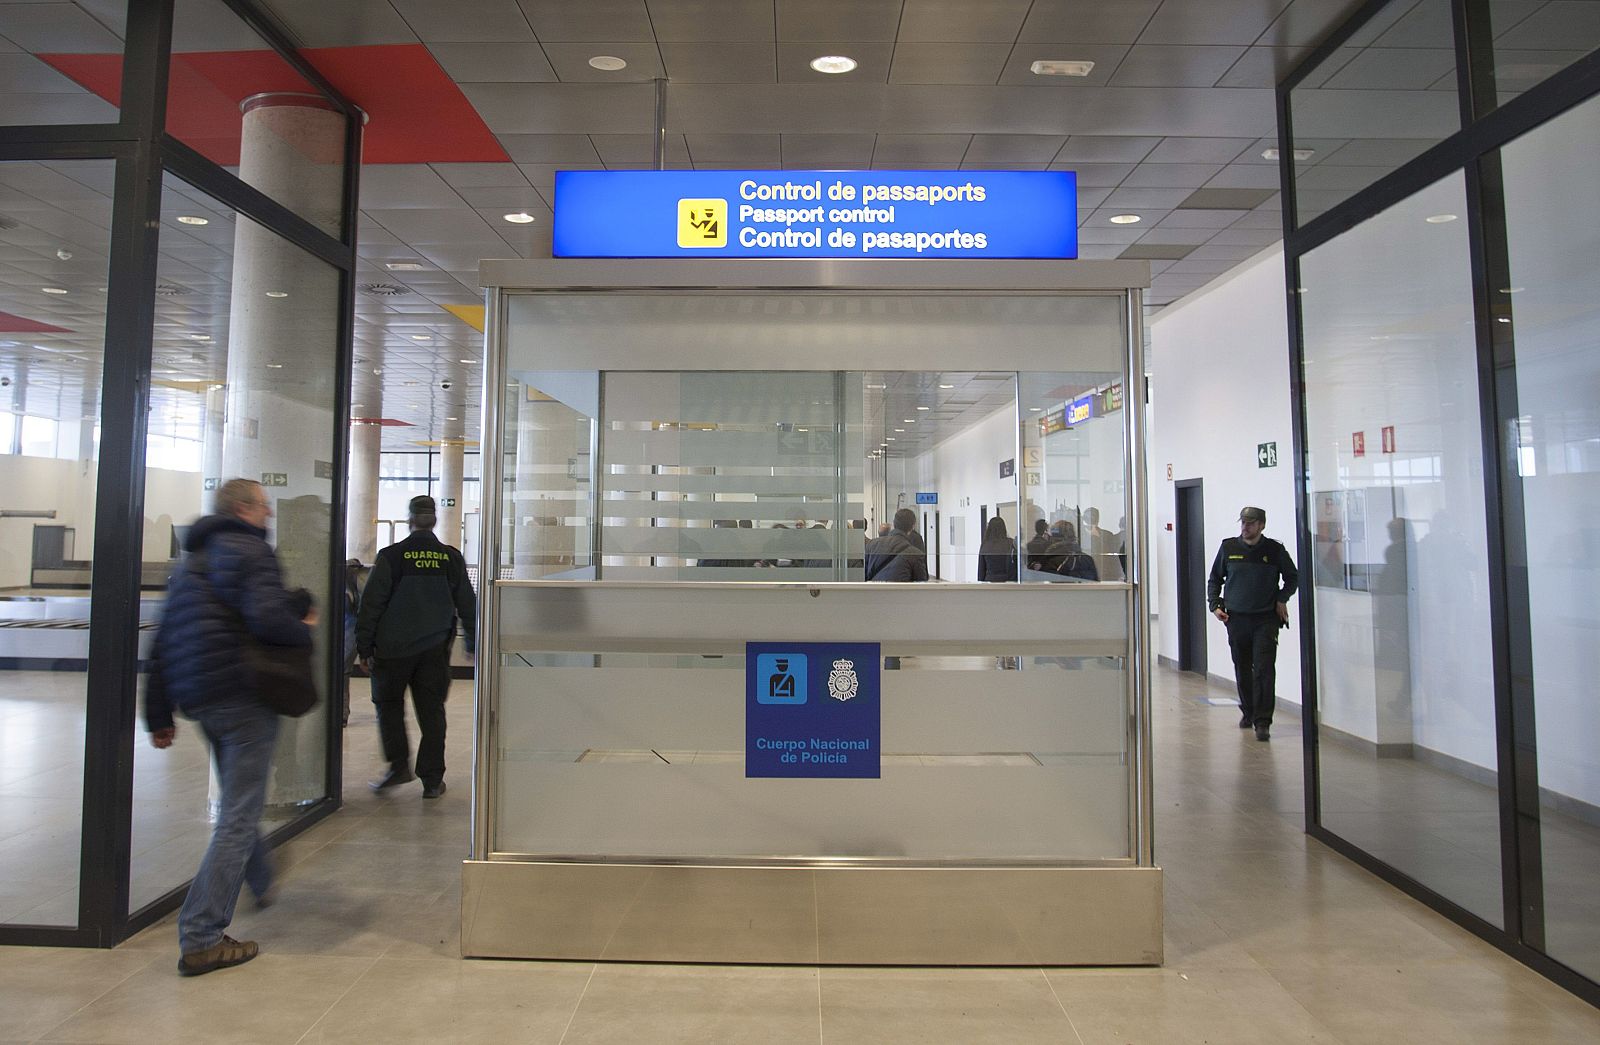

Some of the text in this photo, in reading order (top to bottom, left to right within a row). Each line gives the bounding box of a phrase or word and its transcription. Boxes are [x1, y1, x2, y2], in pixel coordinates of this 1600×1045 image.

[739, 180, 987, 206] Control de passaports
[739, 204, 895, 226] Passport control
[739, 227, 988, 252] Control de pasaportes
[404, 551, 449, 561] GUARDIA
[415, 560, 441, 568] CIVIL
[756, 738, 870, 751] Cuerpo Nacional
[780, 752, 847, 764] de Policía
